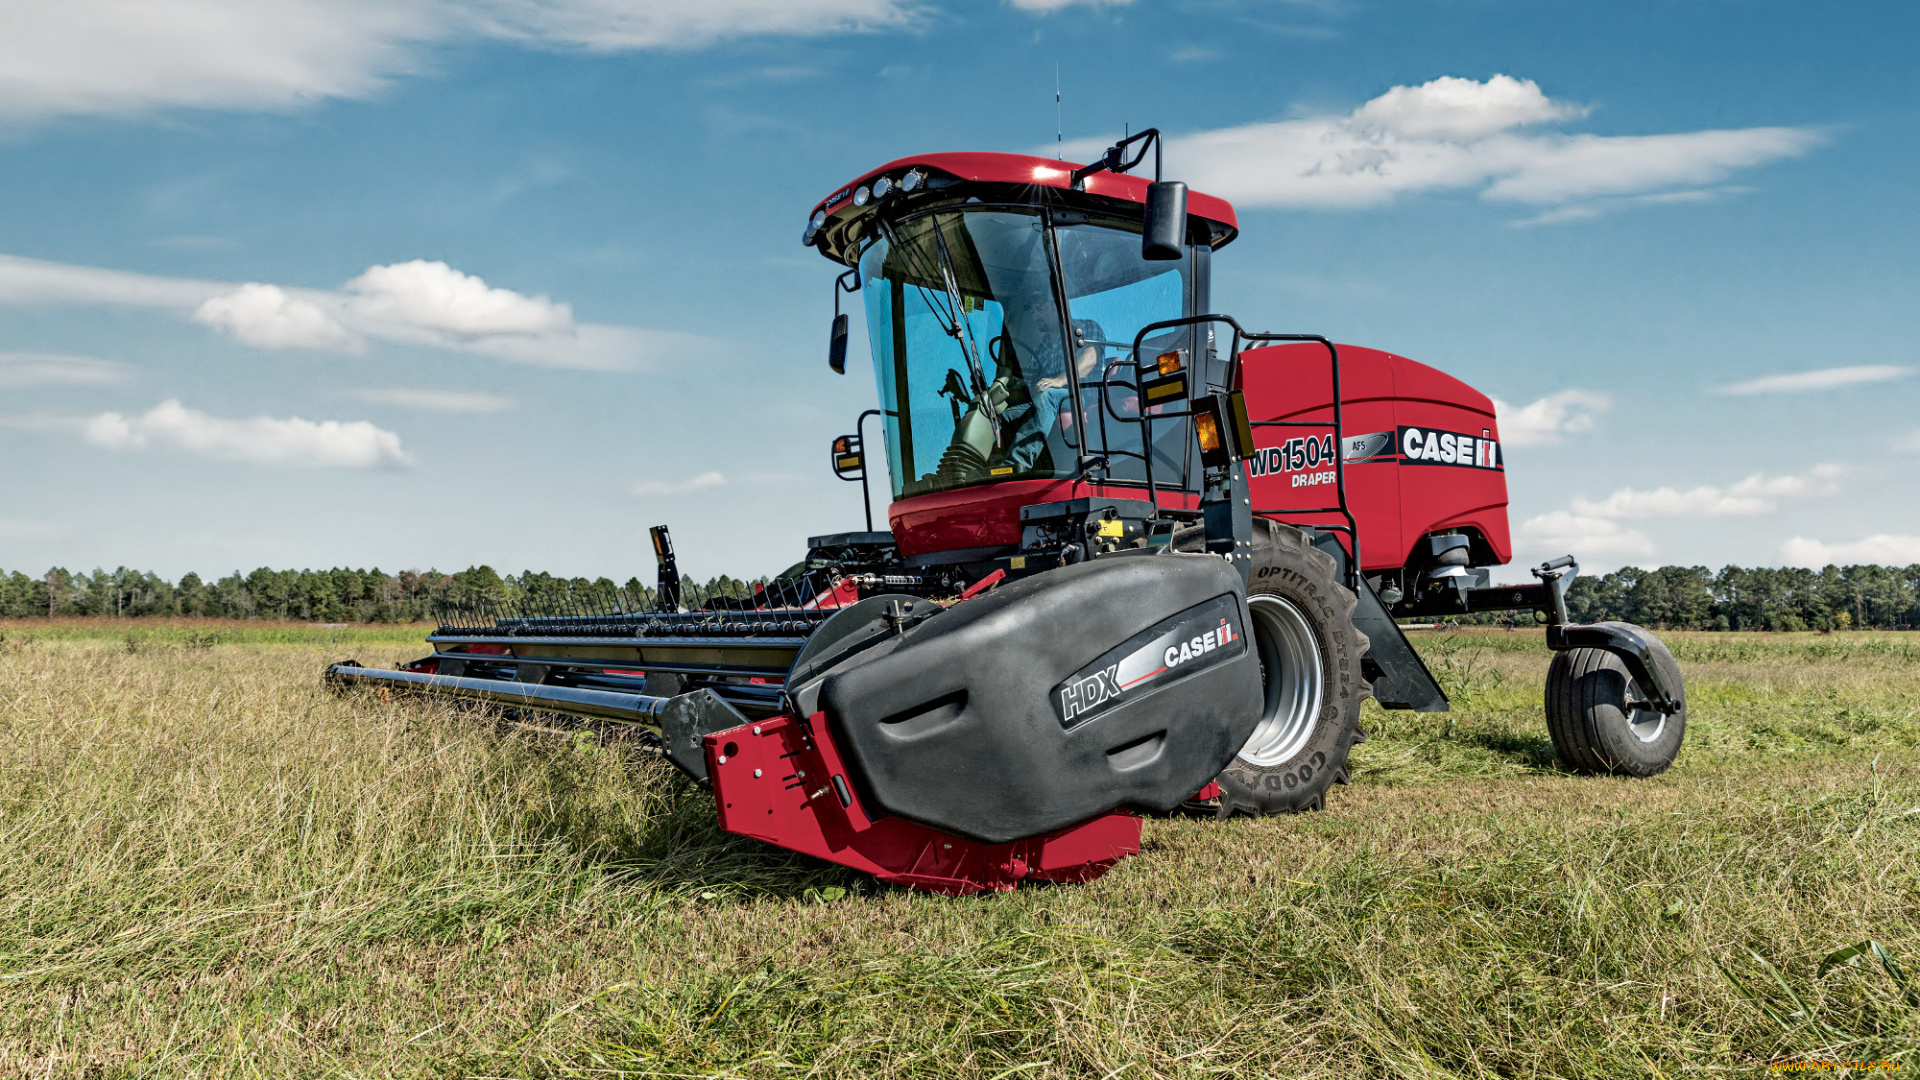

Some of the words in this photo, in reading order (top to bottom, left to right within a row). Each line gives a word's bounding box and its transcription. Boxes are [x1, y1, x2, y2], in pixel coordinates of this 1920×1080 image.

[1250, 434, 1335, 478] WD1504
[1352, 441, 1366, 451] AFS
[1403, 428, 1473, 466] CASE
[1291, 471, 1336, 488] DRAPER
[1257, 566, 1335, 619] OPTITRAC
[1164, 631, 1216, 668] CASE
[1332, 630, 1350, 699] DT824
[1061, 664, 1121, 721] HDX
